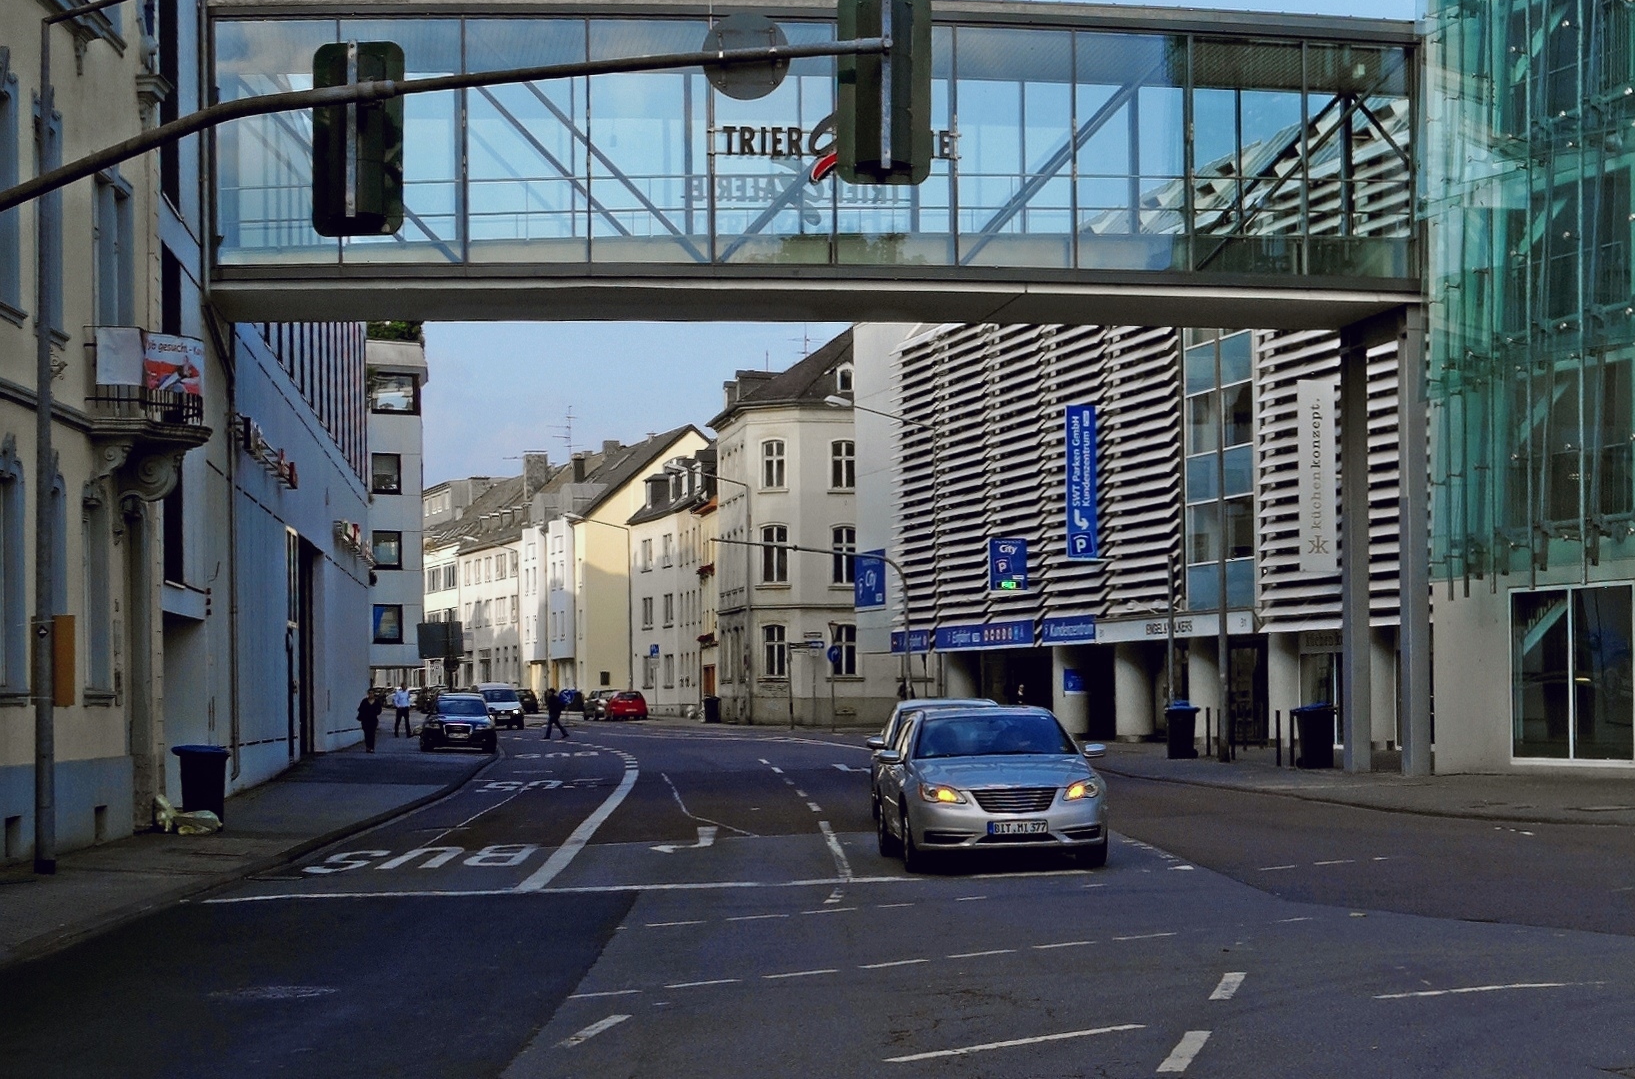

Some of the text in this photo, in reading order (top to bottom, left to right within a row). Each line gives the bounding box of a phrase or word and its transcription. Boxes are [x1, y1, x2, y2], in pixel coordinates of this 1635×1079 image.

[722, 125, 803, 157] TRIER
[1072, 416, 1081, 507] SWT Parken GmbH
[1082, 430, 1091, 507] Kundenzentrum
[301, 843, 541, 875] BUS
